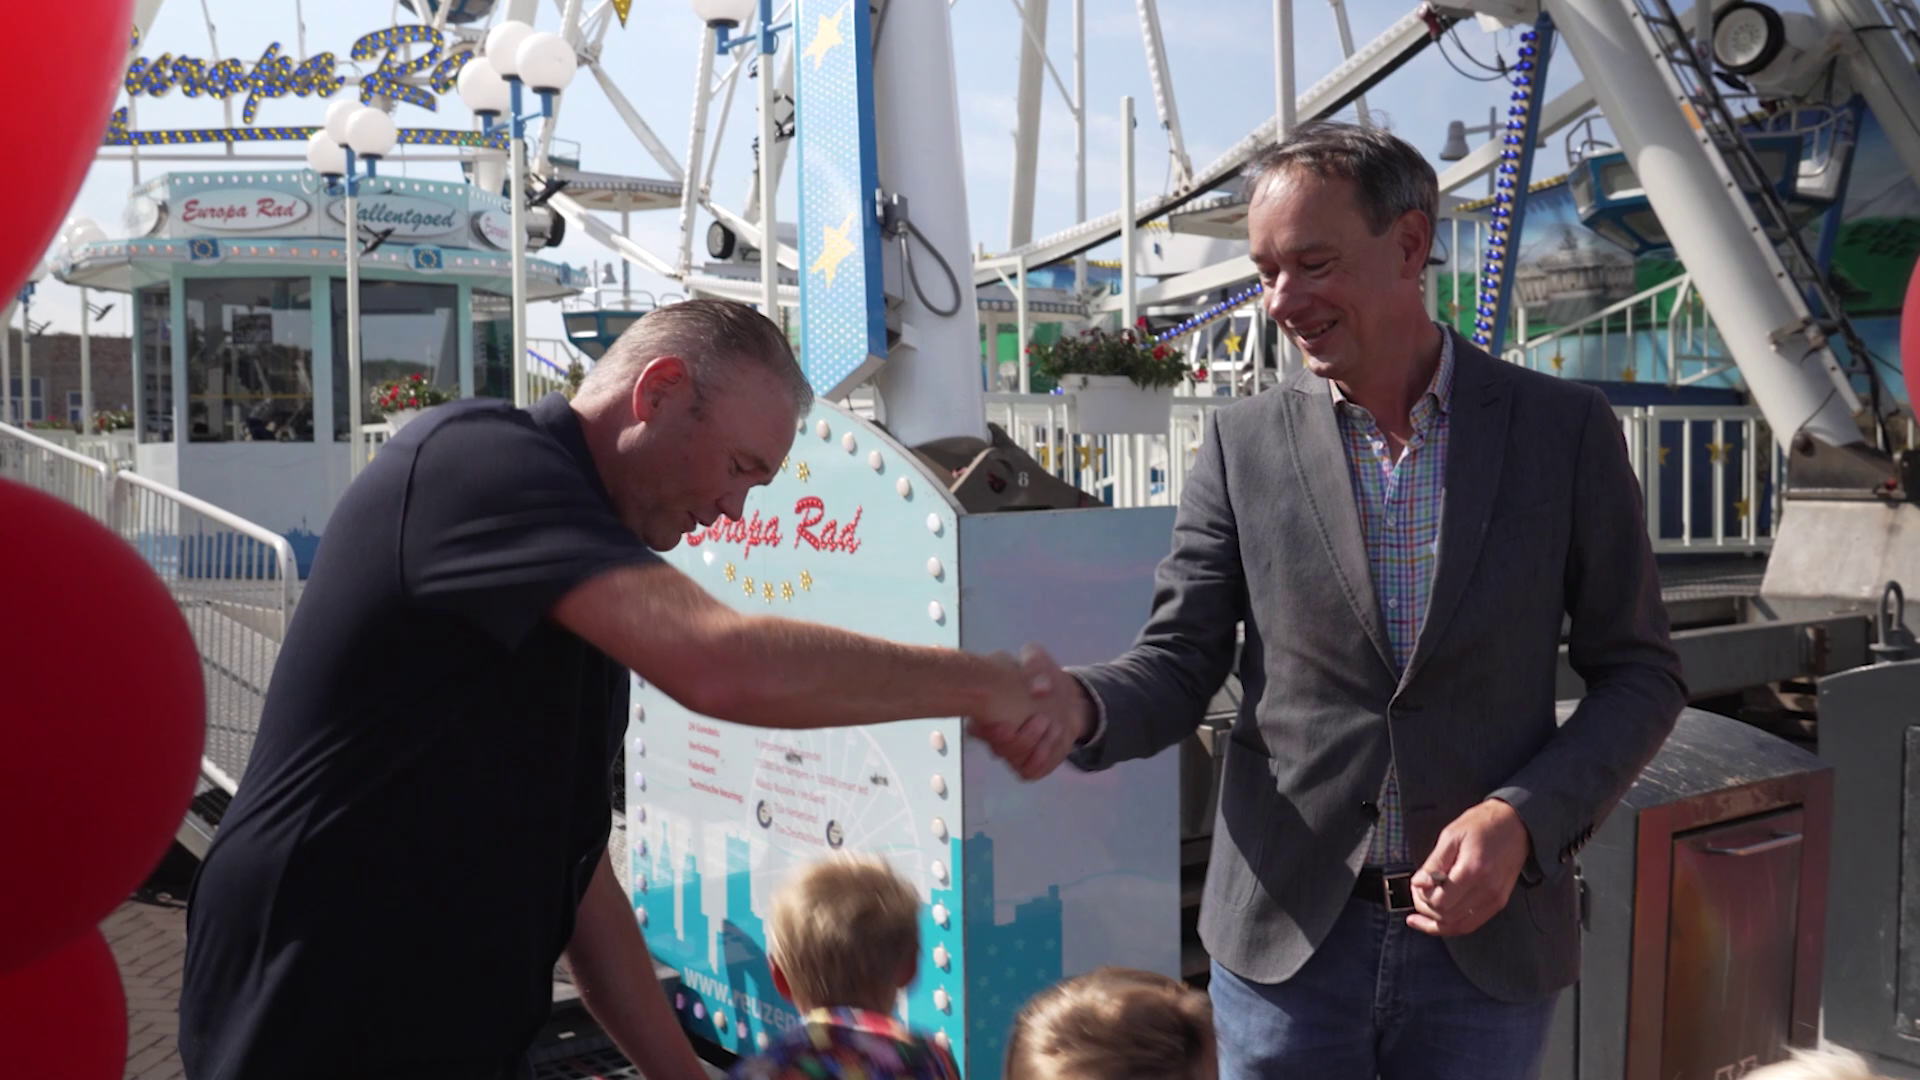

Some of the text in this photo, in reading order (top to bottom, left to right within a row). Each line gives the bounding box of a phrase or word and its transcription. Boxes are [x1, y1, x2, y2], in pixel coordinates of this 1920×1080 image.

[125, 26, 346, 124] uropa
[182, 197, 297, 223] Europa Rad
[342, 202, 456, 232] allentgoed
[1018, 471, 1029, 488] 8
[794, 496, 863, 555] Rad
